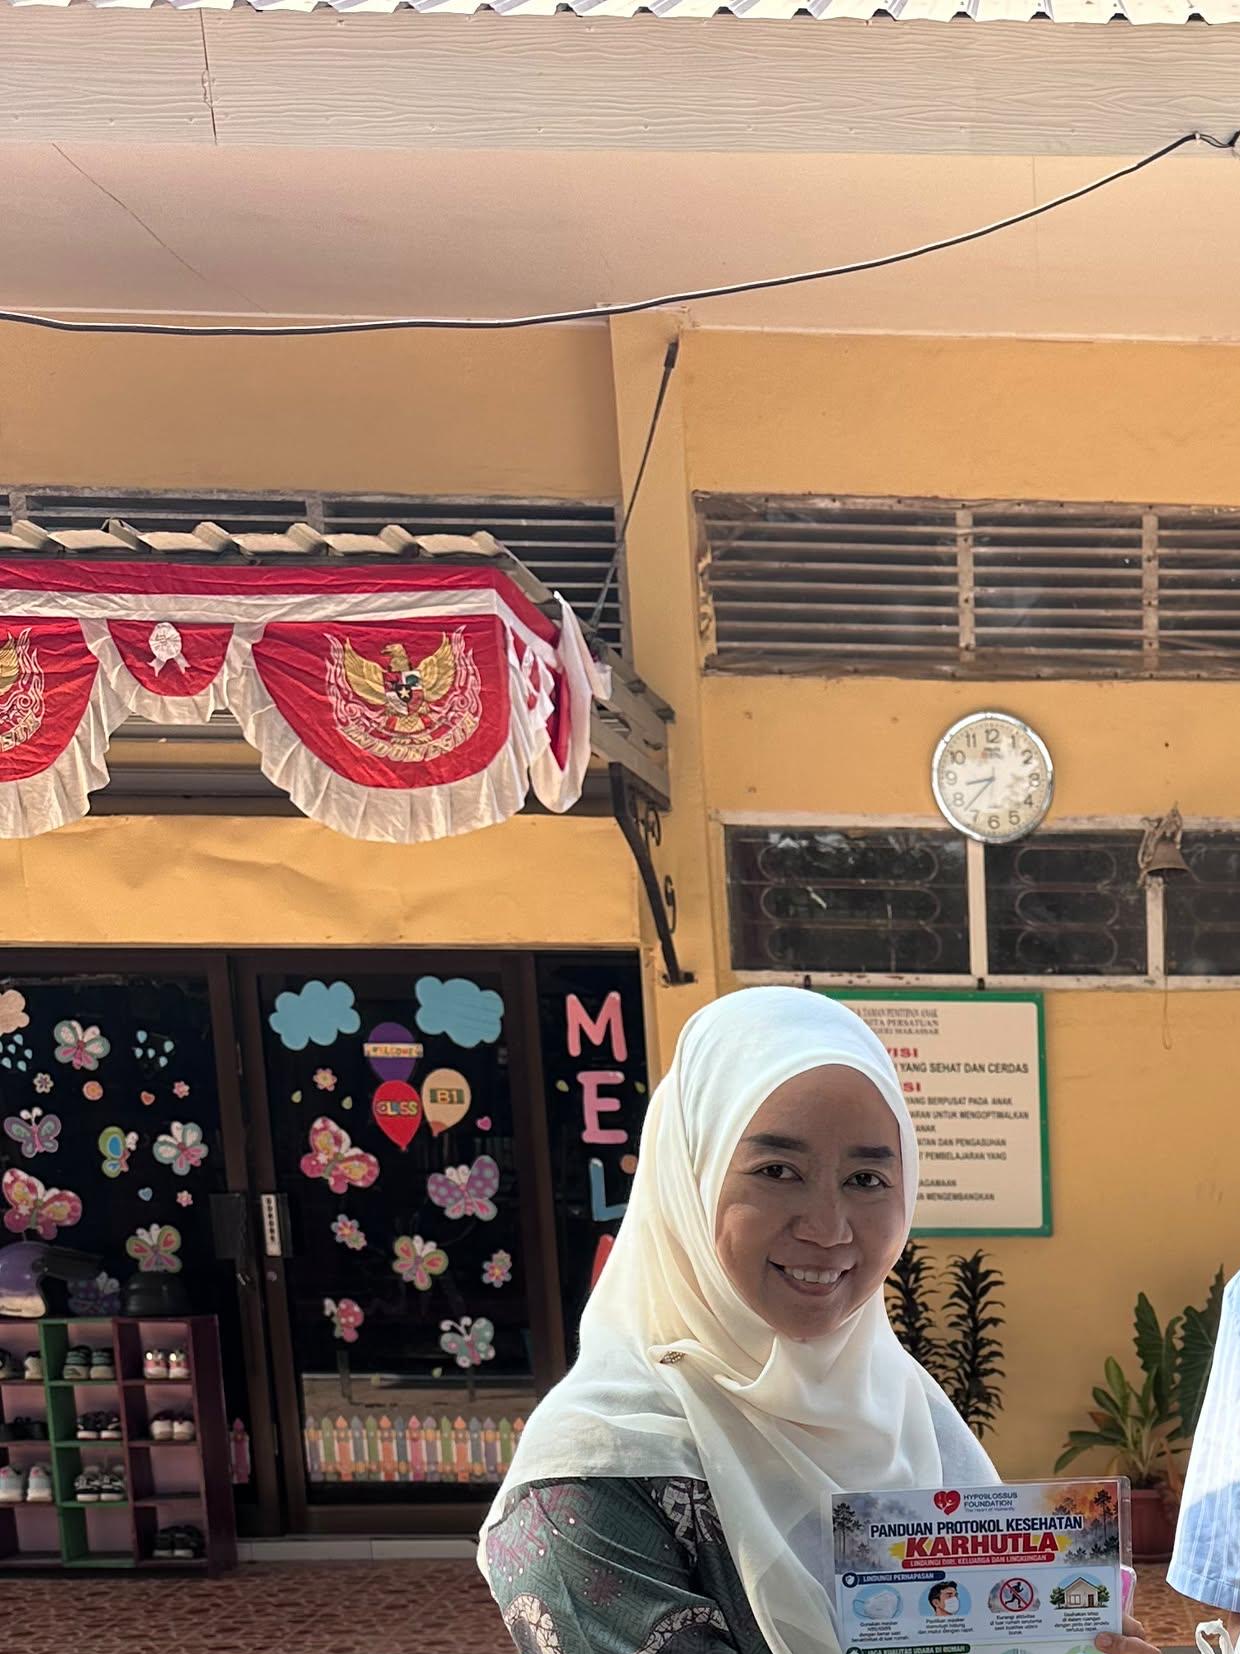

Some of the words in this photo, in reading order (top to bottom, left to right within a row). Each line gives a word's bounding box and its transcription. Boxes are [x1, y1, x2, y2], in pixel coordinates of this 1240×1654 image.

[338, 711, 478, 762] INDONESIA
[966, 732, 977, 748] 11
[985, 729, 1000, 743] 12
[1011, 735, 1016, 749] 1
[950, 750, 966, 765] 10
[1023, 750, 1033, 764] 2
[945, 771, 957, 785] 9
[1029, 773, 1040, 787] 3
[953, 792, 964, 807] 8
[1024, 794, 1034, 807] 4
[969, 810, 980, 823] 7
[988, 815, 1000, 829] 6
[1009, 811, 1021, 825] 5
[900, 1062, 927, 1073] YANG
[929, 1062, 961, 1073] SEHAT
[964, 1062, 985, 1073] DAN
[988, 1063, 1029, 1073] CERDAS
[903, 1082, 921, 1093] SI
[928, 1097, 967, 1105] BERPUSAT
[992, 1097, 1012, 1105] ANAK
[919, 1179, 957, 1187] AGAMAAN
[964, 1500, 1013, 1508] FOUNDATION
[870, 1522, 933, 1538] PANDUAN
[937, 1519, 1004, 1534] PROTOKOL
[1006, 1515, 1083, 1532] KESEHATAN
[905, 1532, 1059, 1558] KARHUTLA
[893, 1573, 934, 1581] PERNAPASAN
